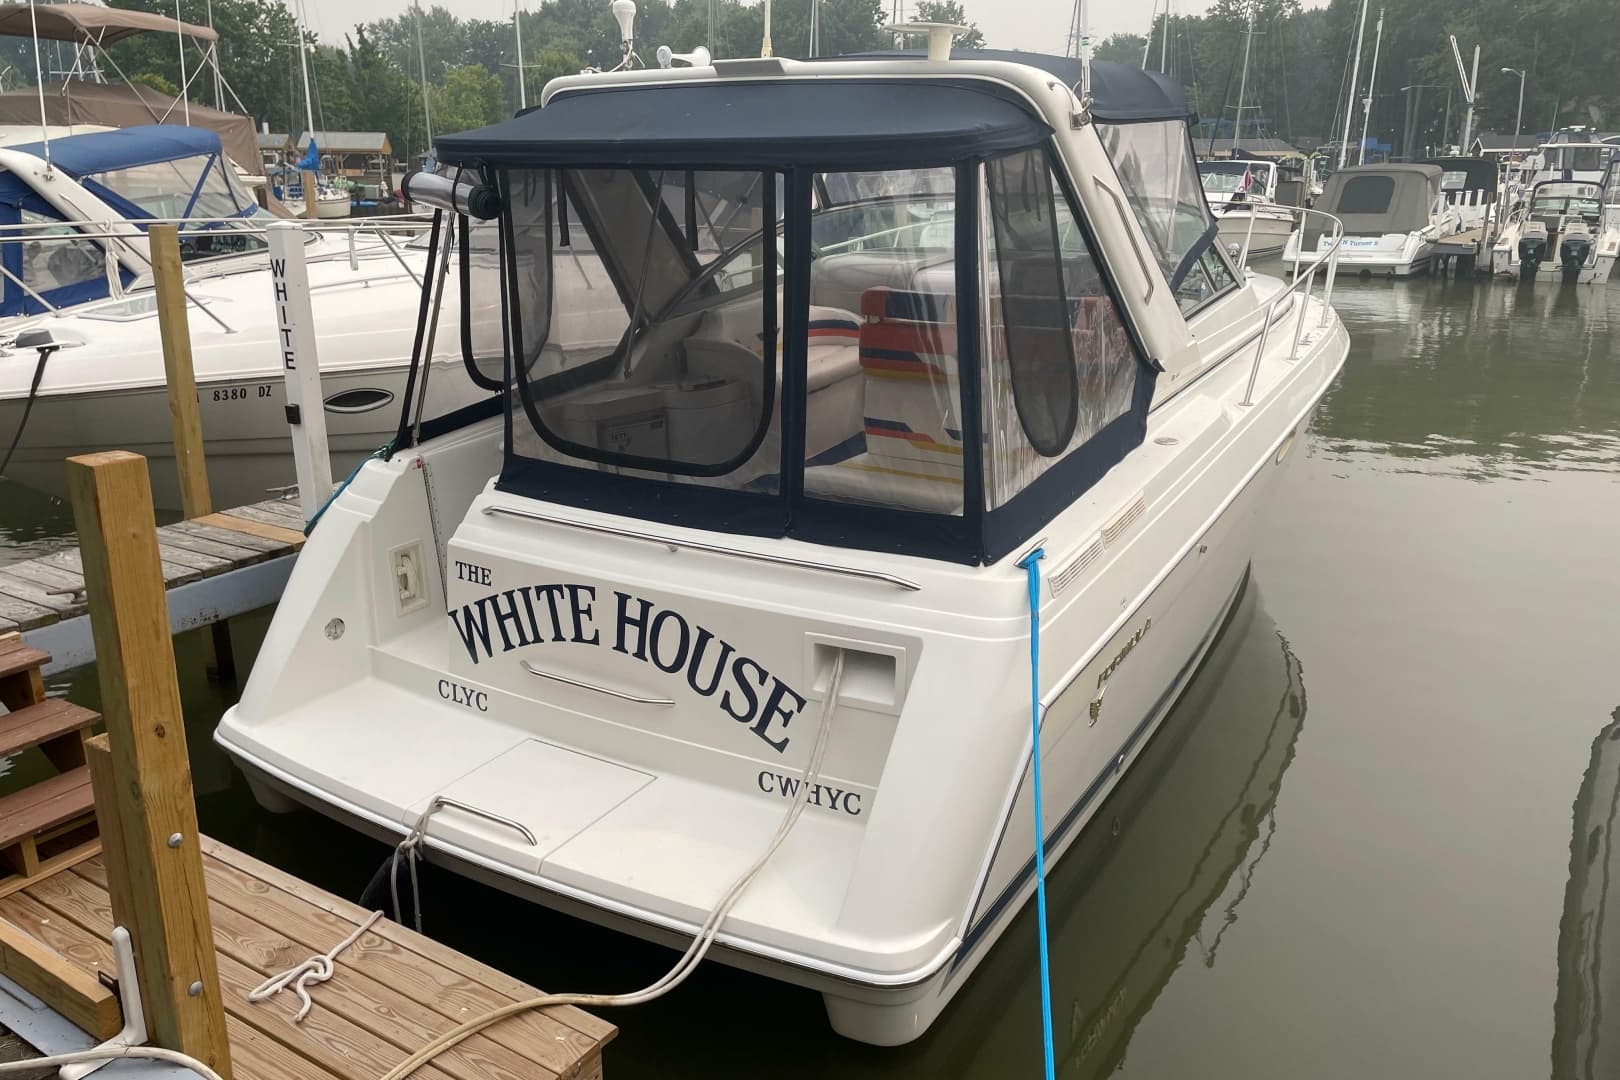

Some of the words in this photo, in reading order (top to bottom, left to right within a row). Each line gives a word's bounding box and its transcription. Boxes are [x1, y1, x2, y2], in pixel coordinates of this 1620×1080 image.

[271, 259, 297, 370] WHITE
[213, 388, 248, 401] 8380
[258, 385, 273, 398] DZ
[455, 560, 492, 587] THE
[447, 583, 600, 666] WHITE
[612, 590, 808, 755] HOUSE
[1096, 617, 1152, 690] FORMULA
[438, 679, 488, 712] CLYC
[758, 770, 862, 816] CWHYC
